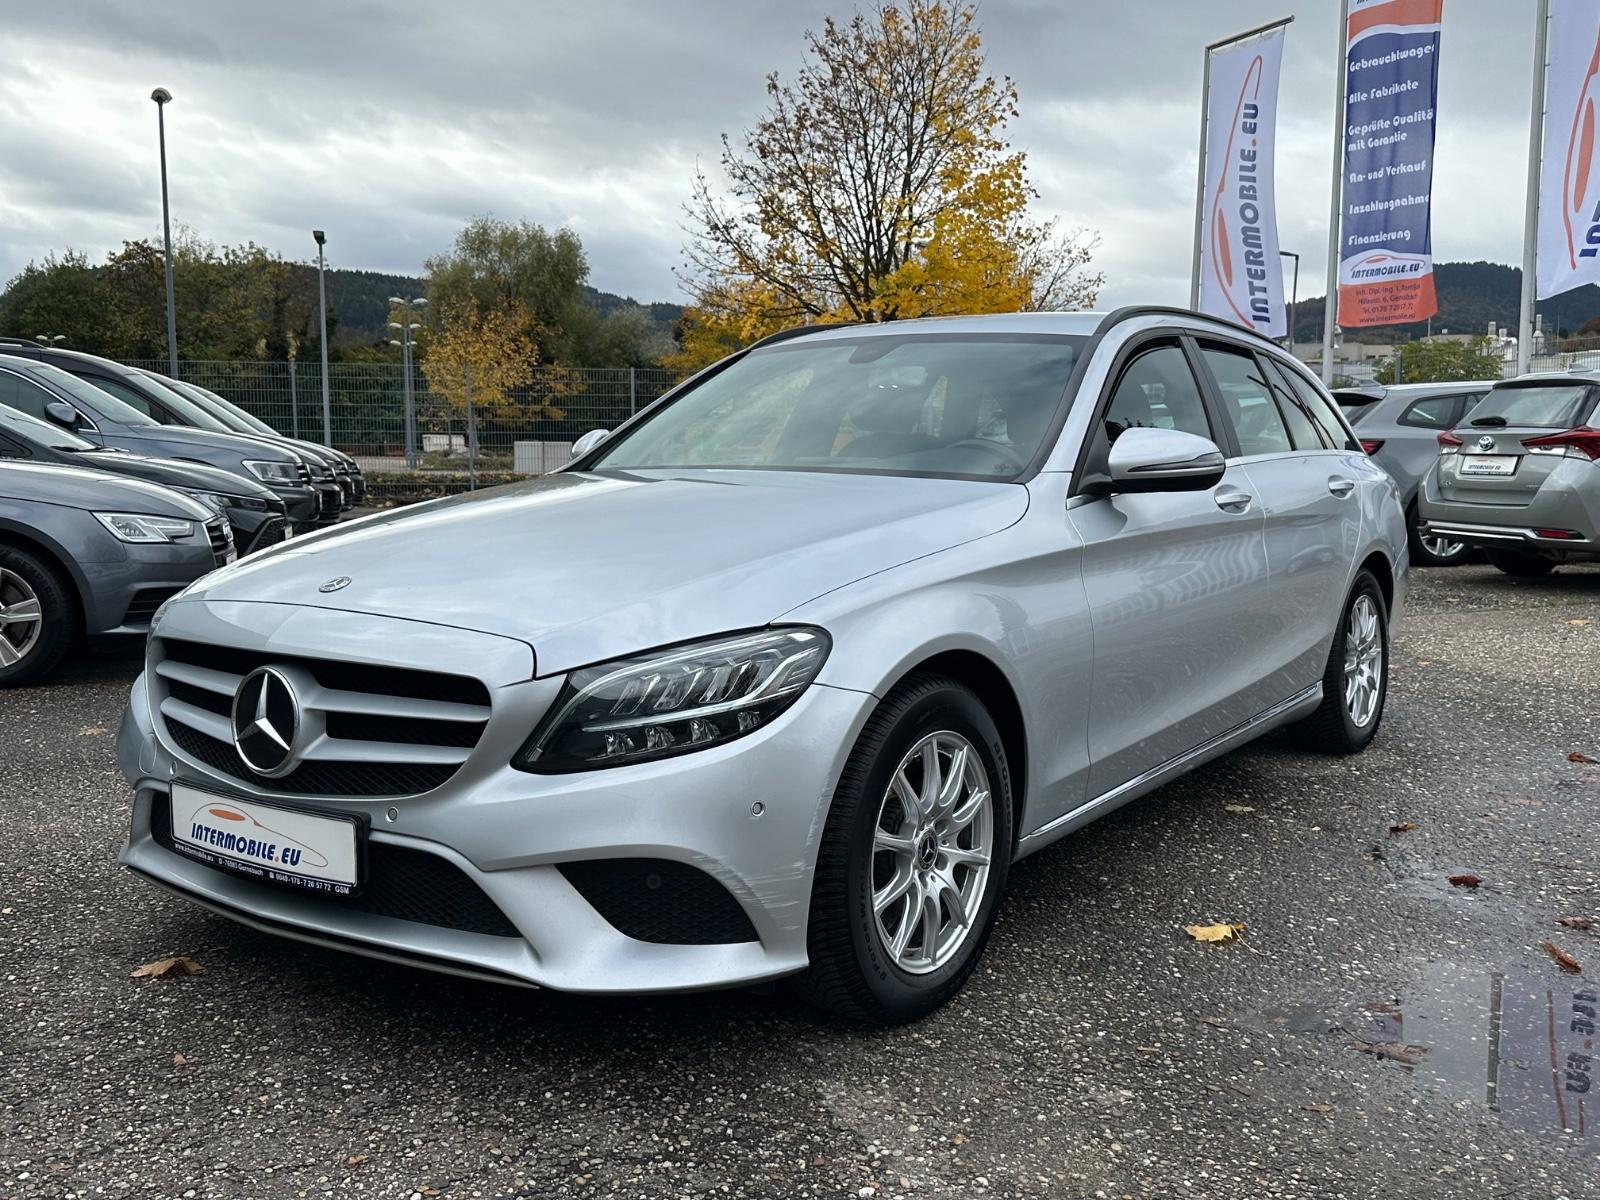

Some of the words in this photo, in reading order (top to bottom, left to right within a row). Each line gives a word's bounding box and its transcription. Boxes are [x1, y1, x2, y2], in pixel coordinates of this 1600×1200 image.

[1349, 91, 1368, 104] Alle
[1370, 80, 1419, 99] Fabrikate
[1348, 120, 1391, 136] Geprüfte
[1393, 108, 1434, 126] Qualitä
[1348, 139, 1366, 152] mit
[1367, 131, 1408, 148] Garantie
[1349, 172, 1366, 183] An-
[1367, 168, 1384, 180] und
[1386, 160, 1426, 176] Verkauf
[1239, 103, 1271, 323] INTERMOBILE.EU
[1348, 229, 1411, 246] Finanzierung
[1351, 263, 1420, 279] INTERMOBILE.EU
[191, 822, 302, 867] INTERMOBILE.EU
[335, 885, 350, 895] GSM
